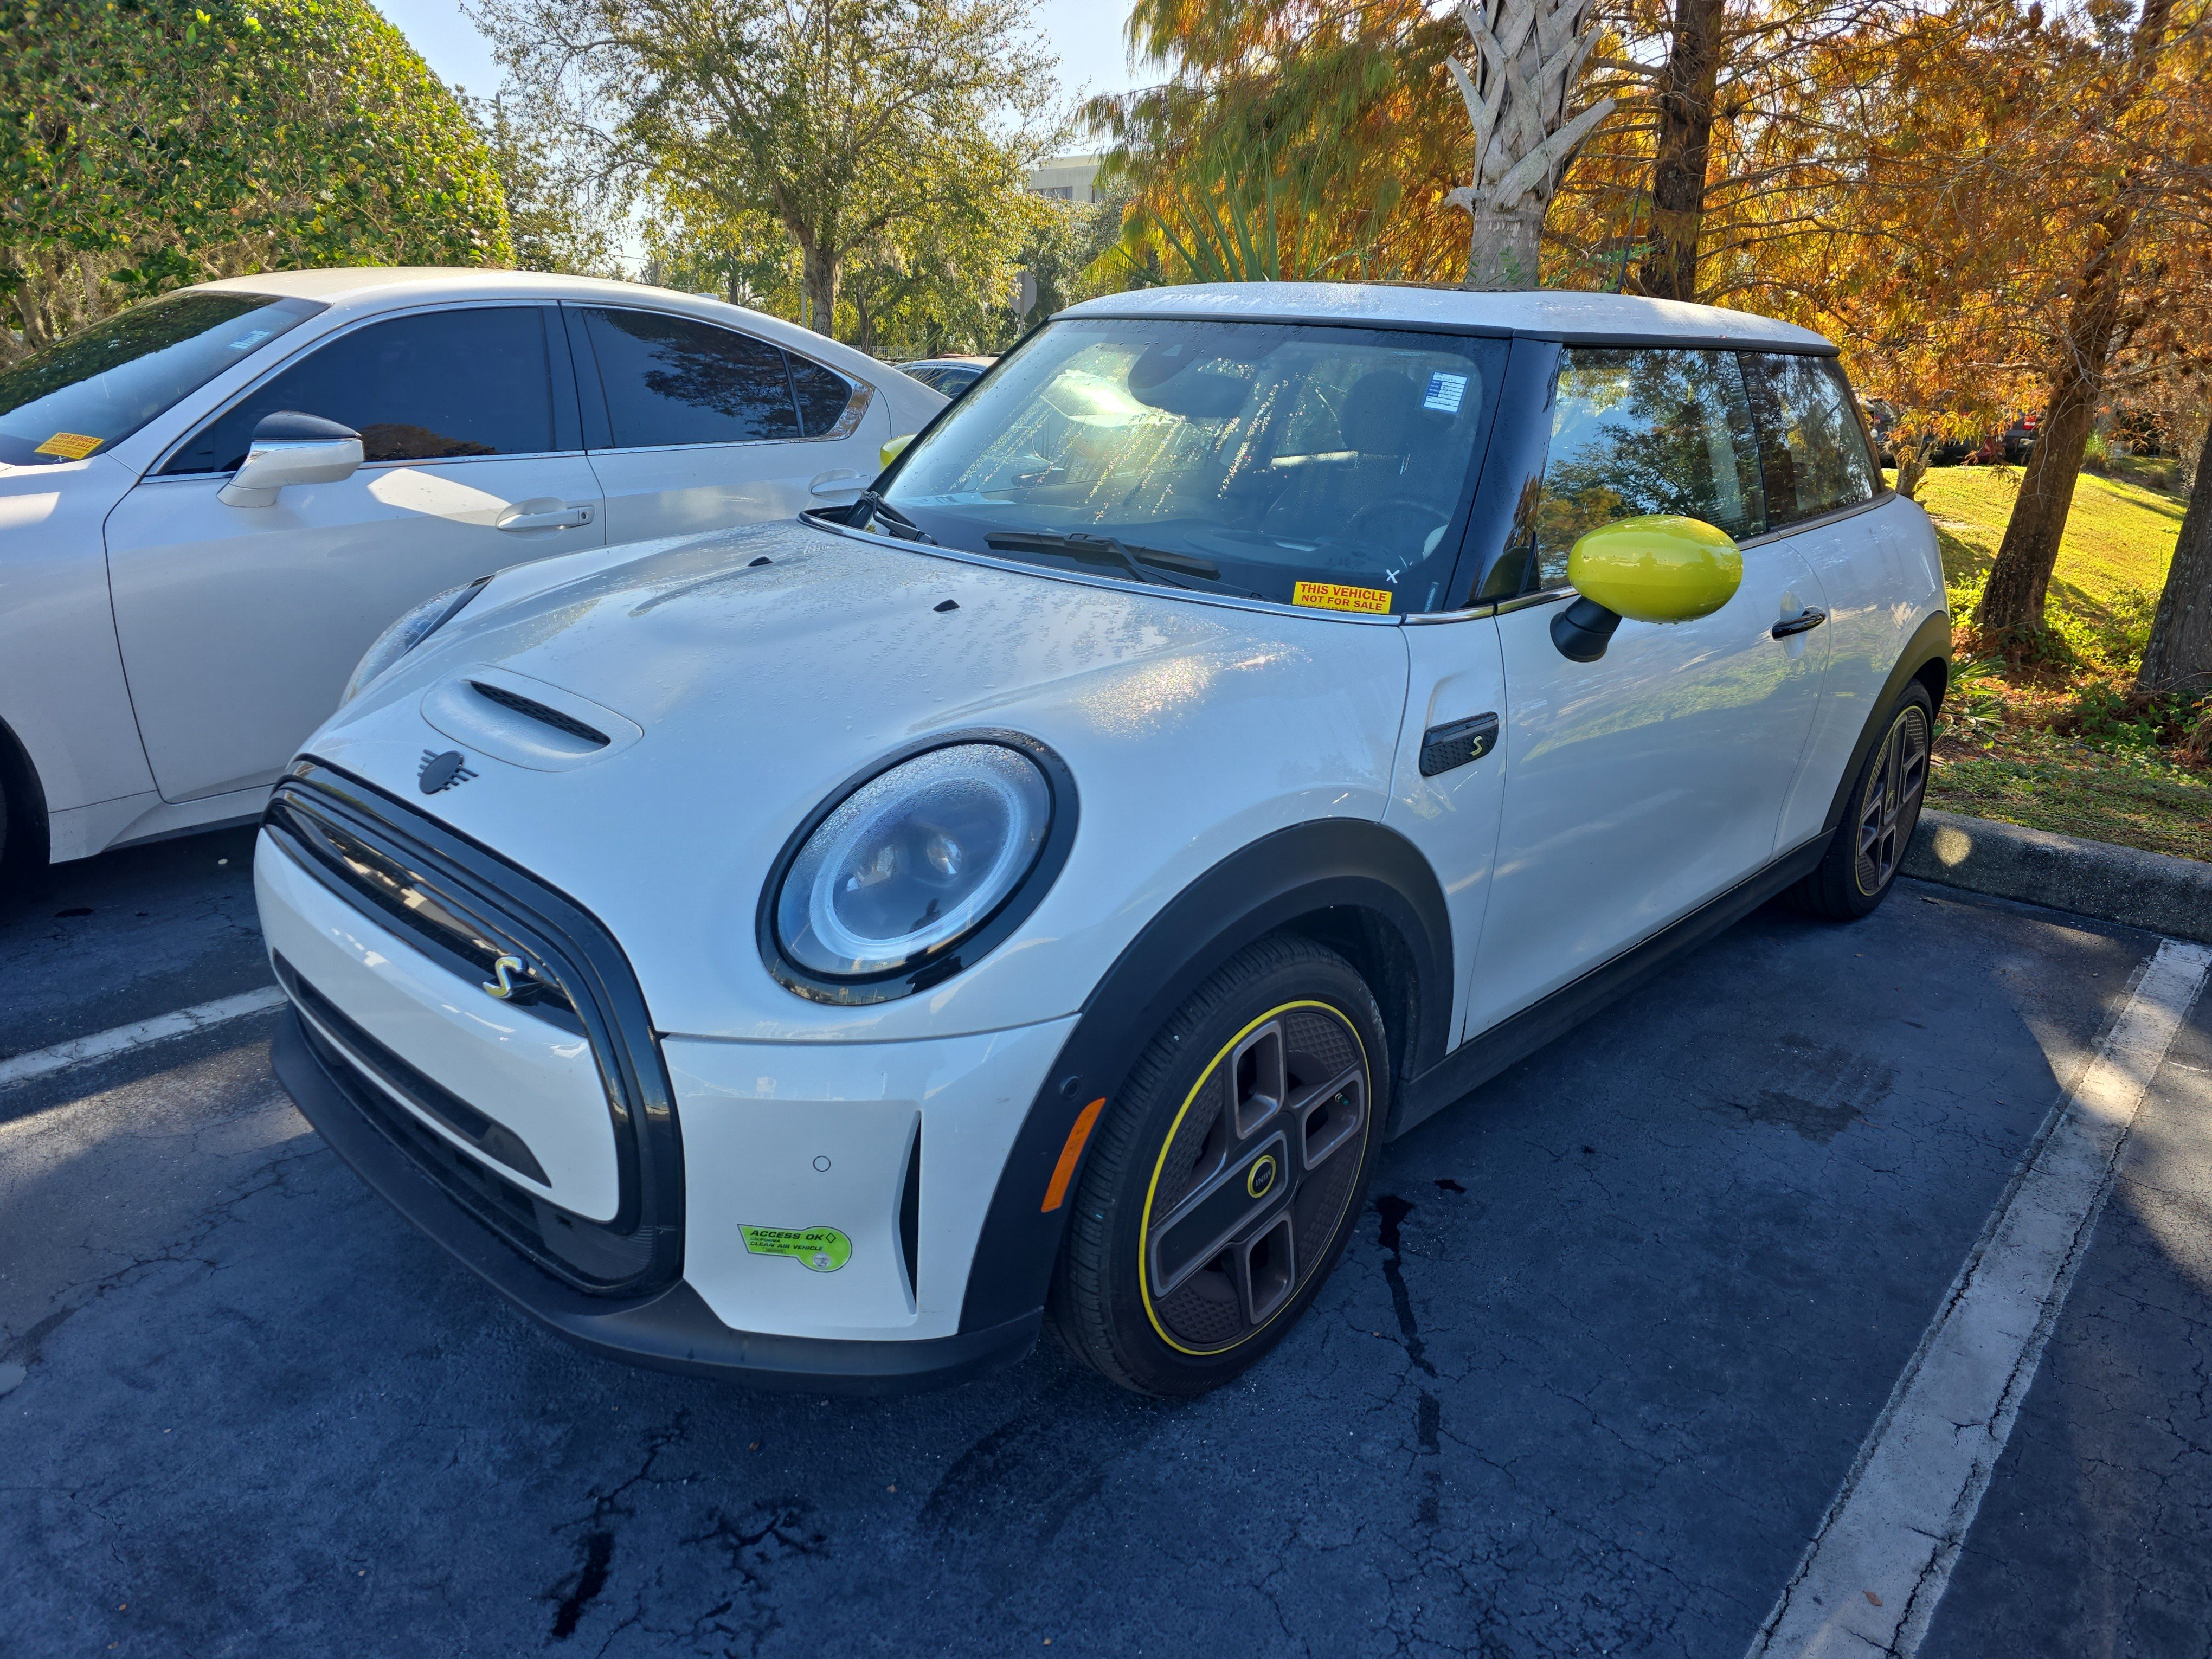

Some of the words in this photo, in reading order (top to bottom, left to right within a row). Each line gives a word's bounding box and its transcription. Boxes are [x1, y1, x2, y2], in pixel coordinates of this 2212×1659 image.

[72, 435, 101, 445] VEHICLE
[1301, 583, 1329, 594] THIS
[1333, 586, 1387, 602] VEHICLE
[1301, 595, 1324, 603] NOT
[1327, 597, 1350, 606] FOR
[1353, 600, 1382, 611] SALE
[1469, 736, 1483, 756] S
[483, 956, 523, 999] S
[1255, 1168, 1271, 1186] MINI
[750, 1230, 801, 1239] ACCESS
